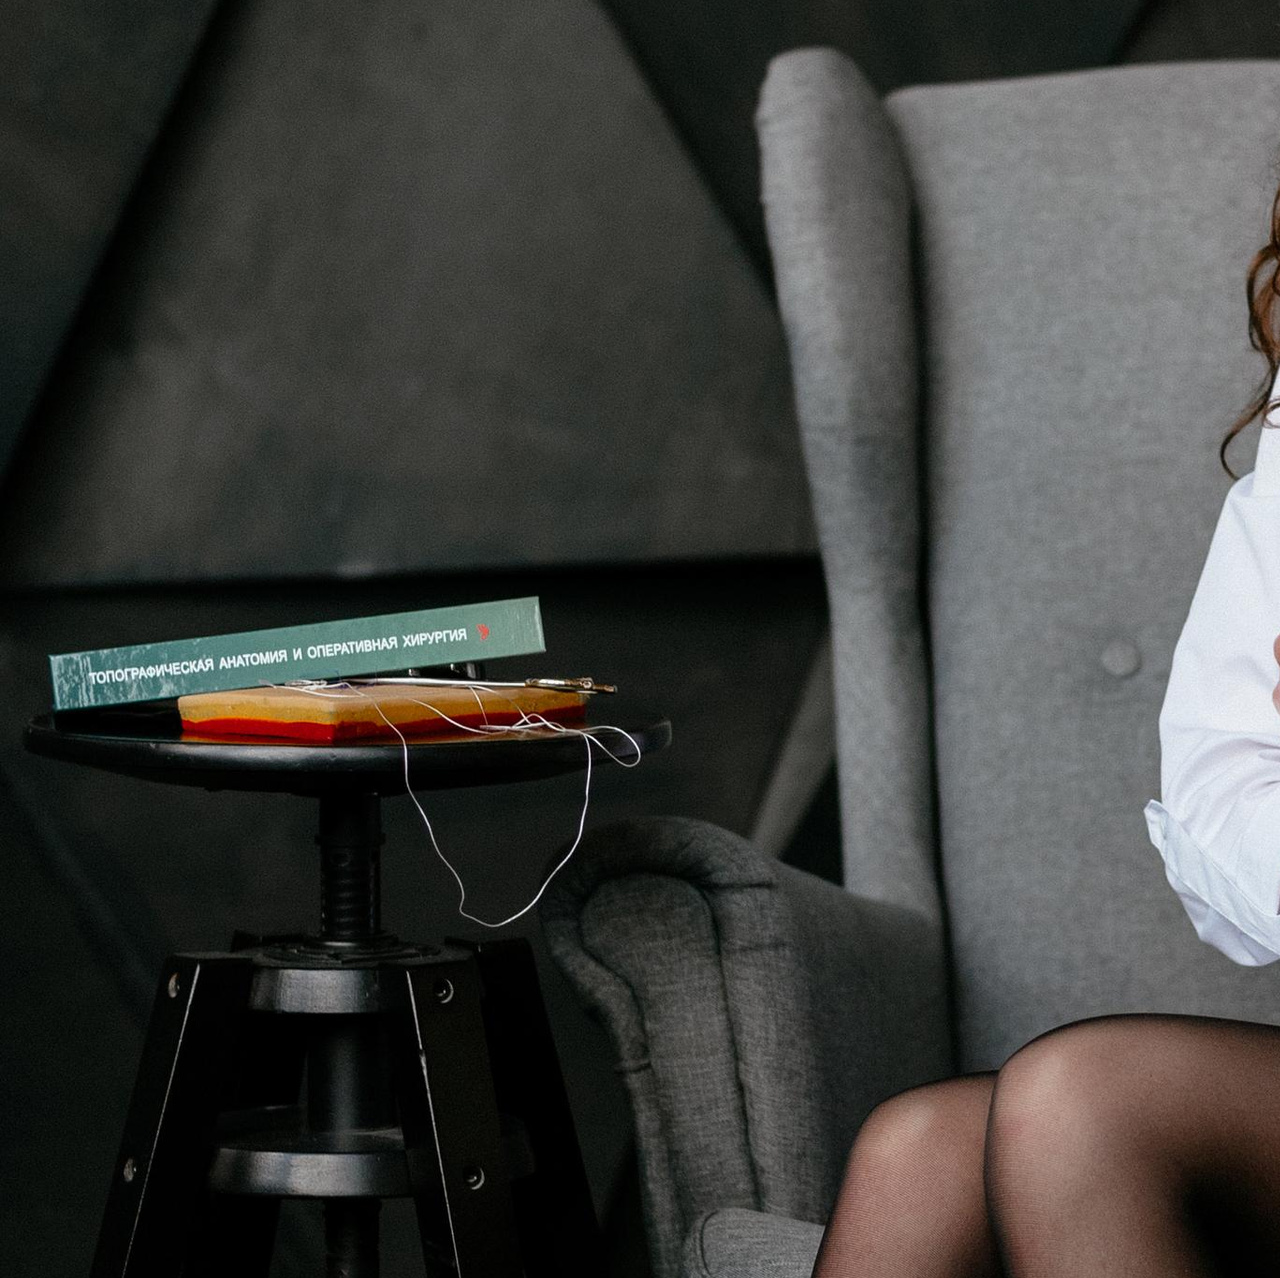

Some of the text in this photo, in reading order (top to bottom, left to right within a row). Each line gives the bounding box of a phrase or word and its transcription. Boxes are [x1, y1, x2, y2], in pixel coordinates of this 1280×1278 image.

[89, 628, 468, 685] ТОПОГРАФИЧЕСКАЯ АНАТОМИЯ И ОПЕРАТИВНАЯ ХИРУРГИЯ
